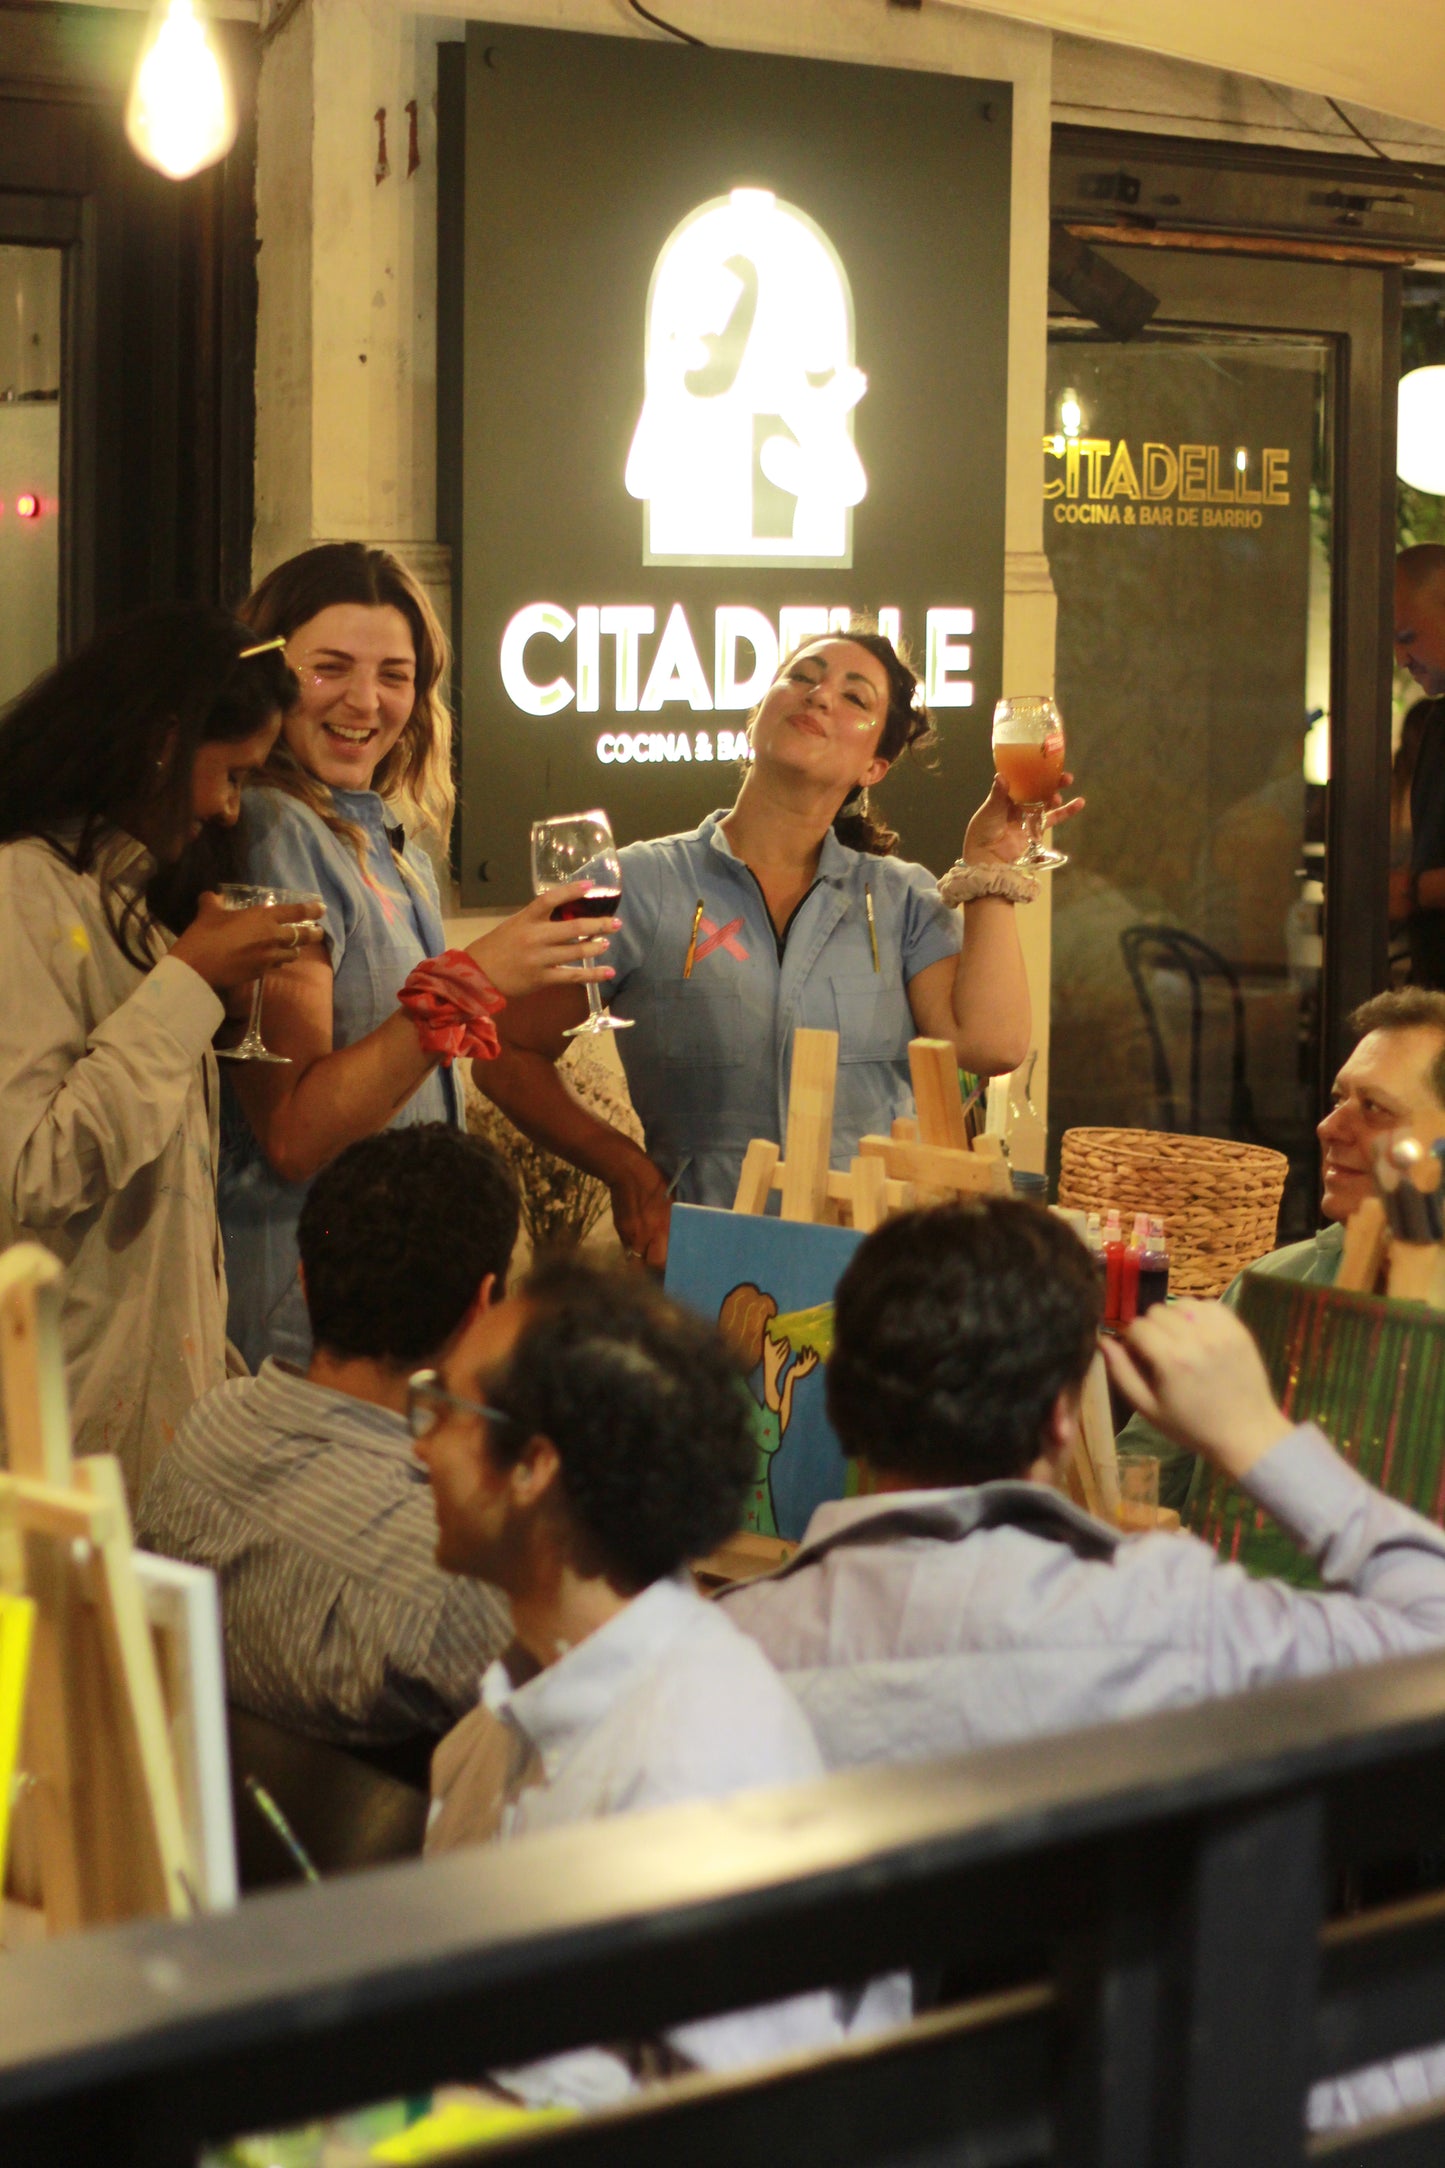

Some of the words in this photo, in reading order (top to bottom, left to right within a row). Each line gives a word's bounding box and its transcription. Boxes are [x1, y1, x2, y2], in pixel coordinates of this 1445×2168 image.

[374, 100, 421, 187] 11
[1054, 504, 1121, 524] COCINA
[1124, 505, 1136, 525] &
[1139, 506, 1173, 526] BAR
[1177, 507, 1199, 527] DE
[1202, 508, 1263, 529] BARRIO
[597, 732, 692, 764] COCINA
[695, 731, 714, 761] &
[716, 731, 756, 761] BA
